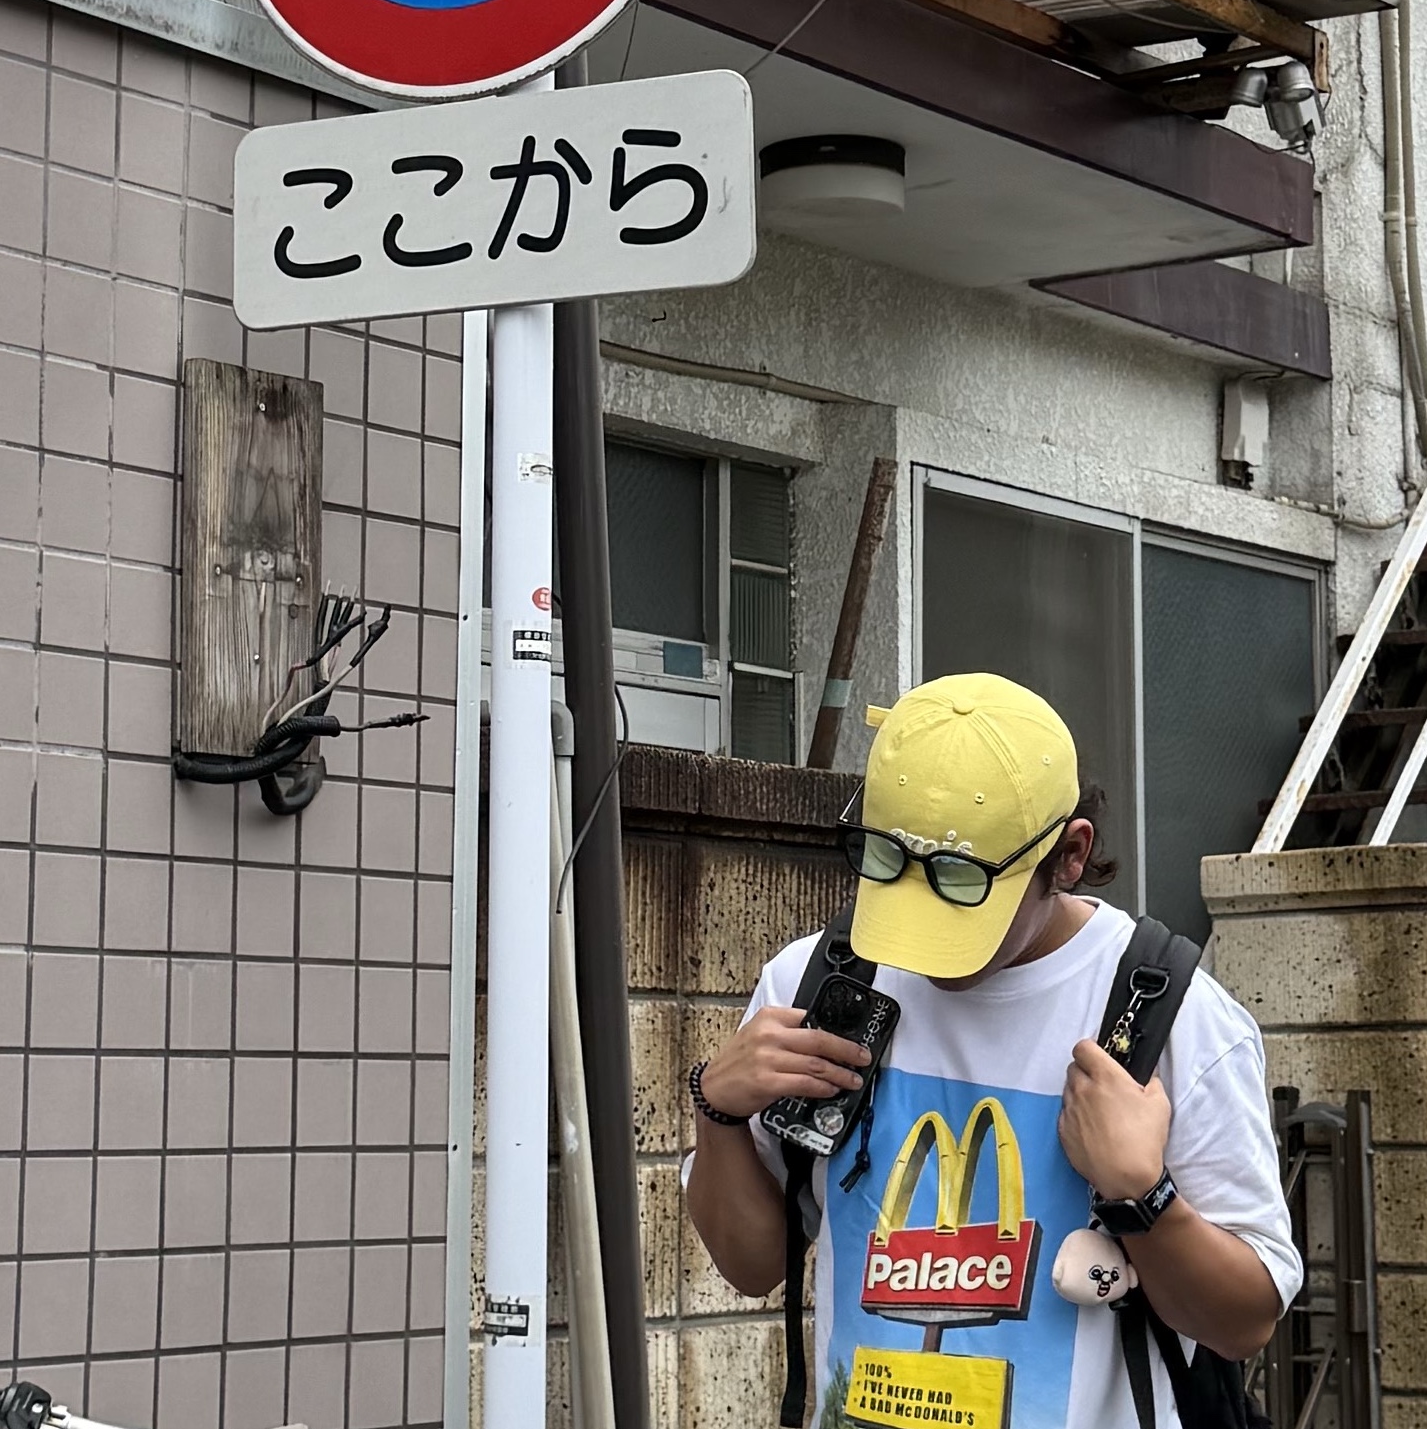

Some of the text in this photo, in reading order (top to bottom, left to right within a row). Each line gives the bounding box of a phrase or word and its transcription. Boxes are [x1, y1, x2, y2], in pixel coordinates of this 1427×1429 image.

[273, 128, 709, 279] ここから
[866, 1251, 1012, 1292] Palace
[865, 1363, 892, 1378] 100%
[863, 1379, 952, 1405] I'VE NEVER HAD
[859, 1395, 975, 1426] A BAD McDONALD'S
